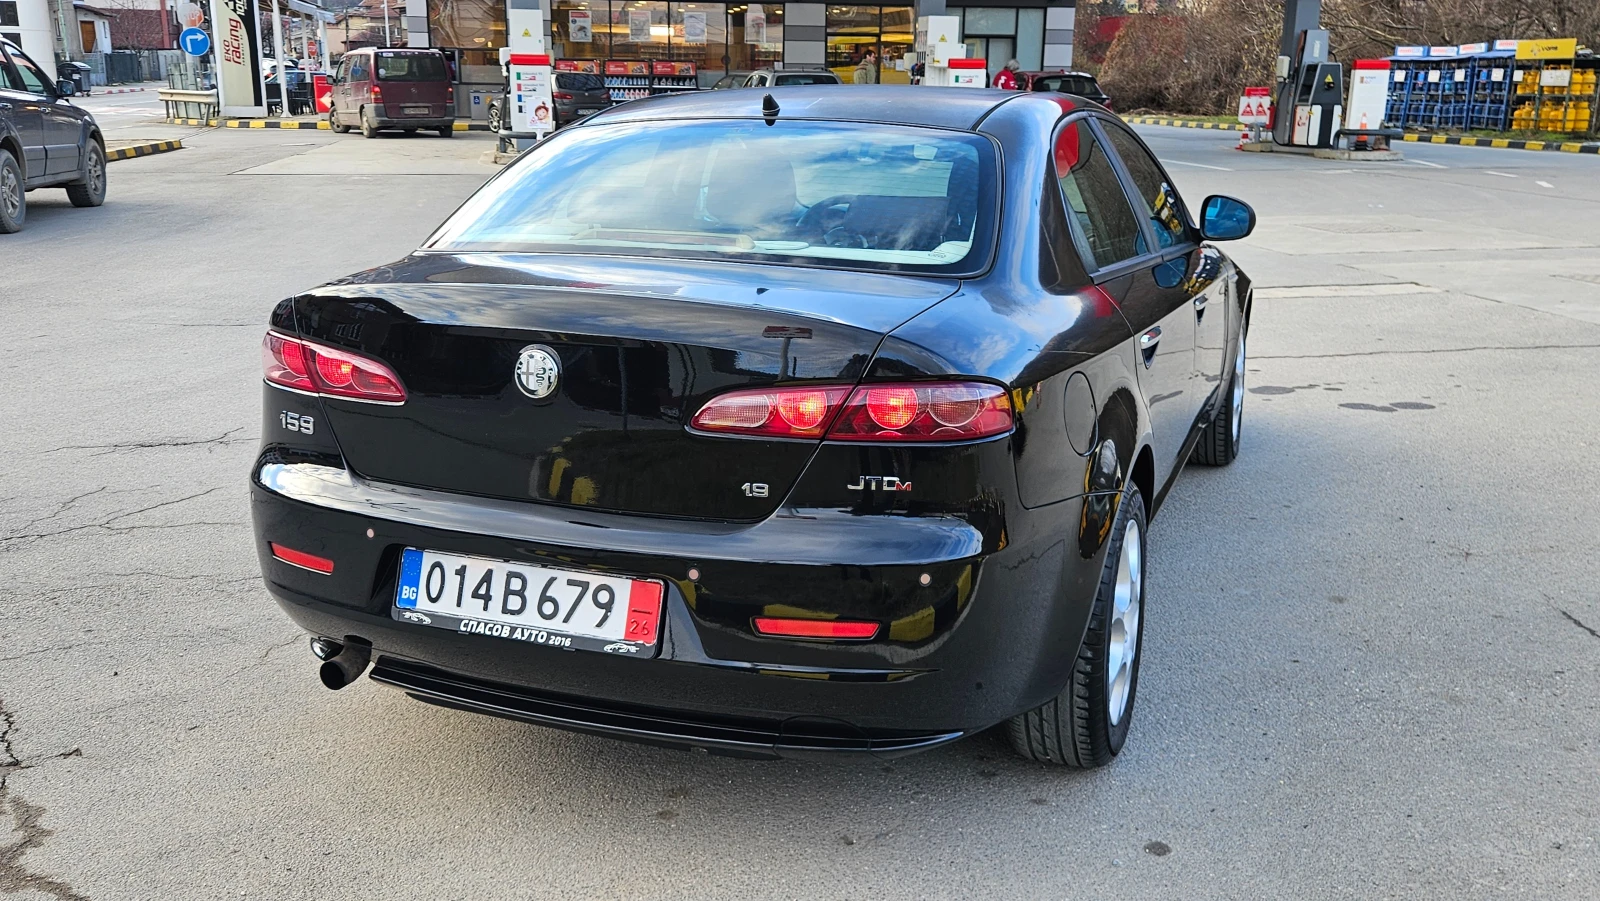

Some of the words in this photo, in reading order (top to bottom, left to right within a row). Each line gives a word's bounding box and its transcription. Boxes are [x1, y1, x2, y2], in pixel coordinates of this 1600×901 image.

[223, 39, 232, 62] EKO
[228, 18, 242, 65] racing
[280, 410, 314, 435] 159
[401, 585, 417, 600] BG
[425, 560, 615, 627] 014B679
[459, 619, 510, 638] СПАСОВ
[512, 626, 548, 643] АУТО
[549, 635, 572, 647] 2016
[629, 618, 650, 636] 26
